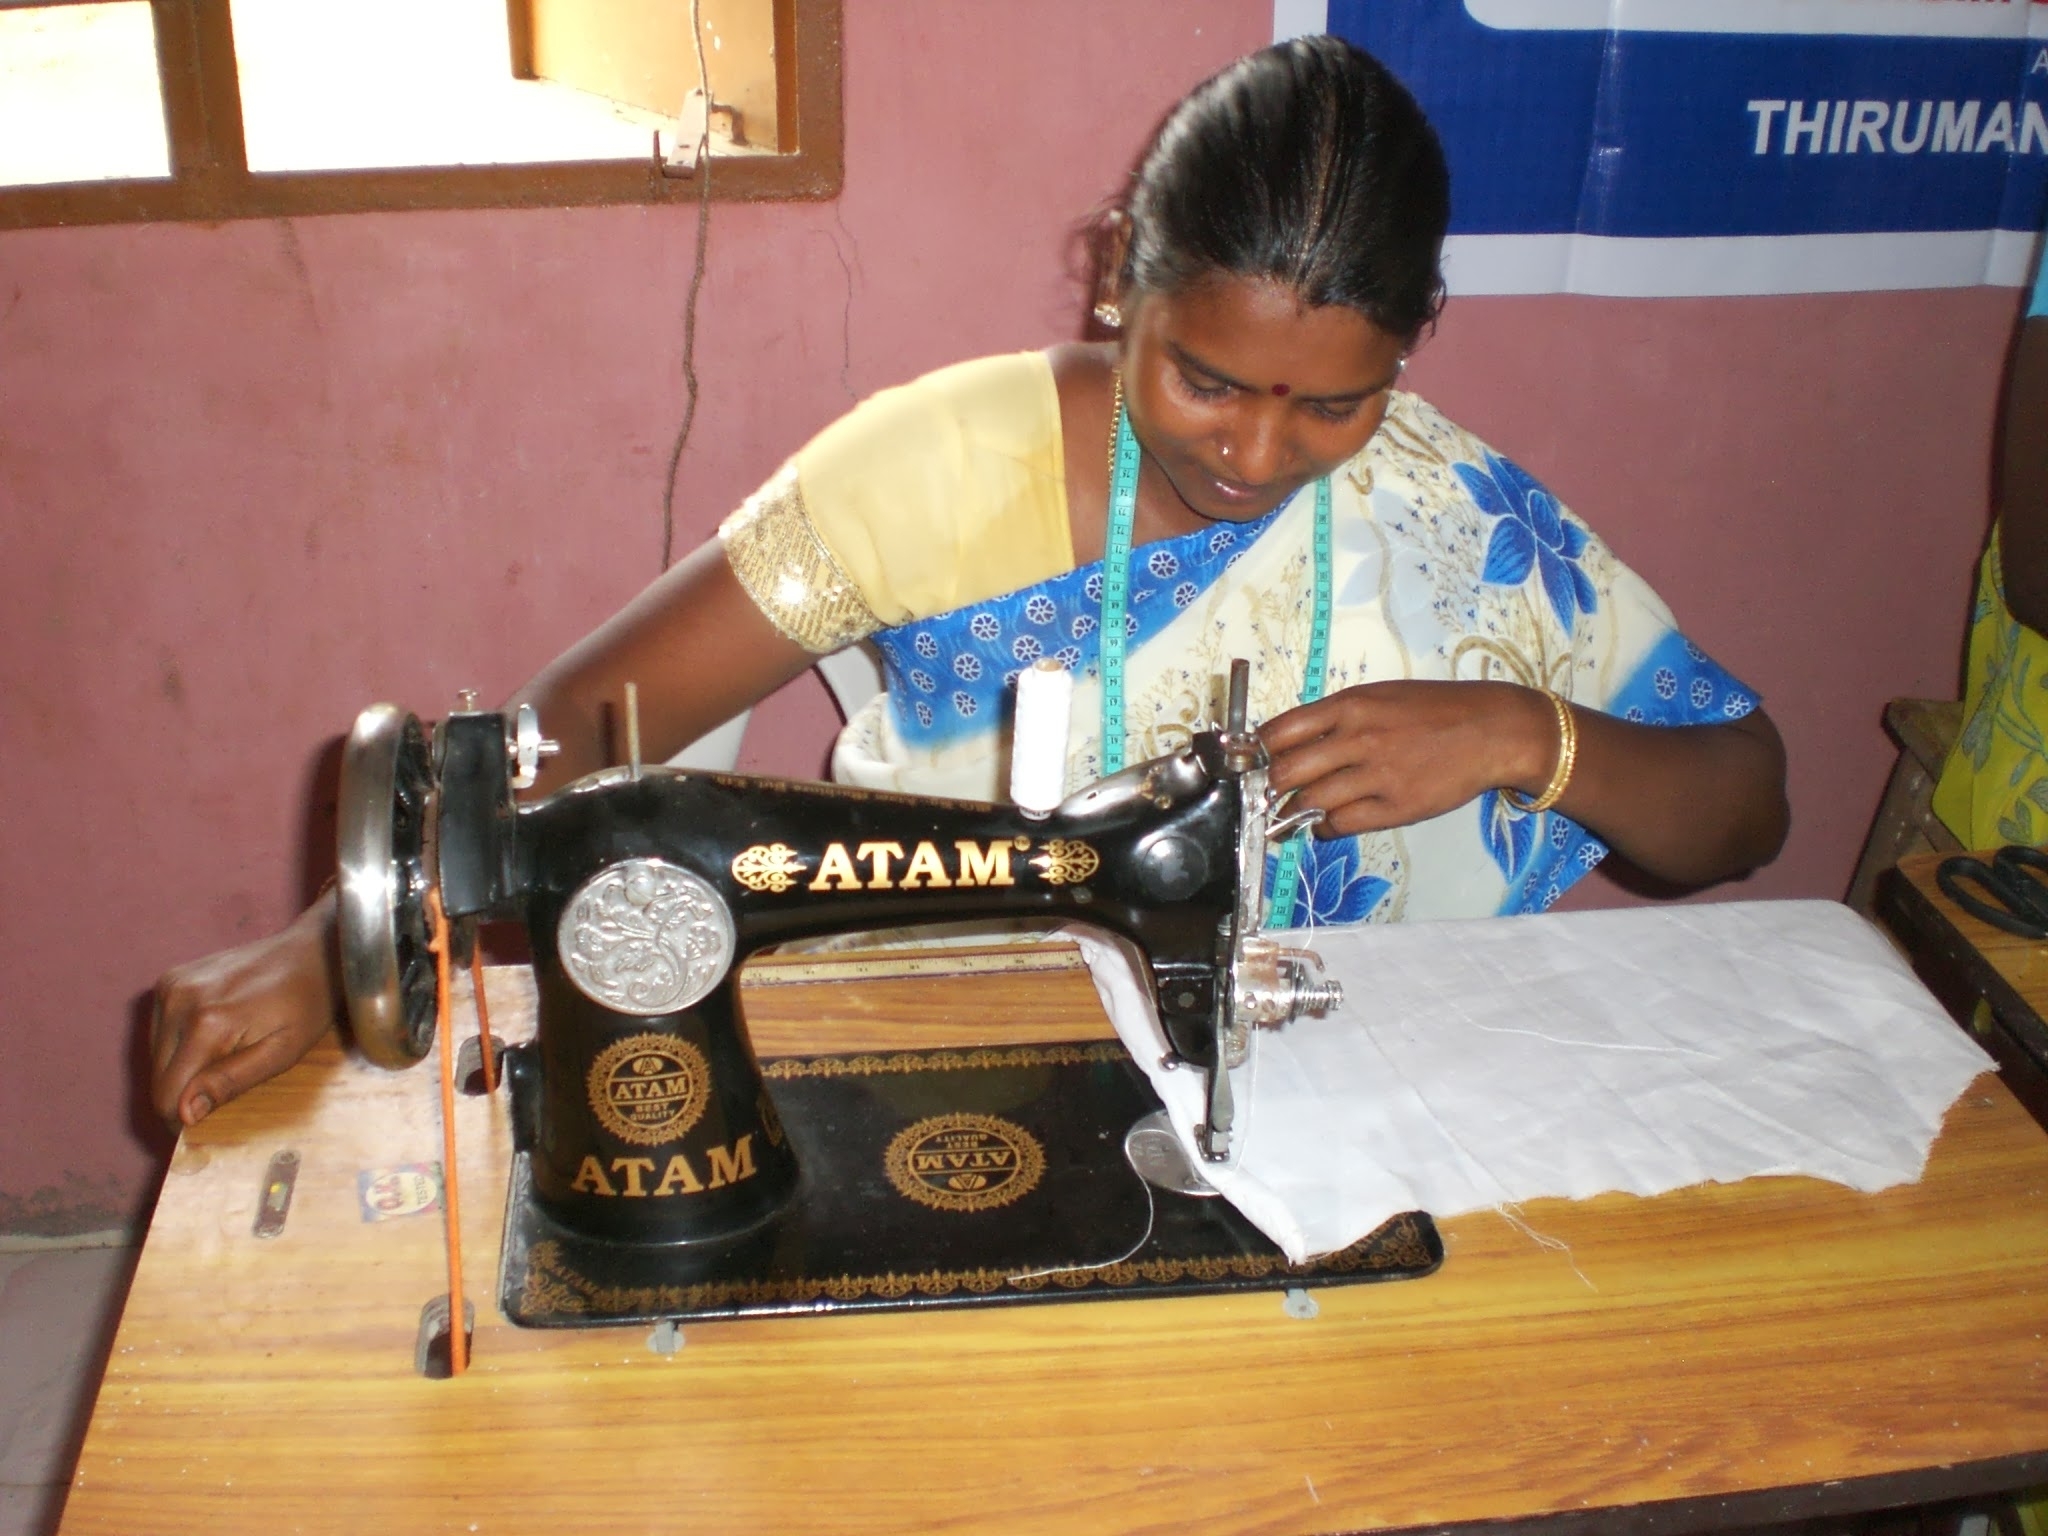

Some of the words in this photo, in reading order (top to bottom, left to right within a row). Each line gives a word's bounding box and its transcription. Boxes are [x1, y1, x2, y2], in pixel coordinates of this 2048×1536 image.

[1747, 100, 2048, 155] THIRUMAN
[808, 840, 1015, 891] ATAM
[614, 1077, 686, 1100] ATAM
[629, 1109, 675, 1121] QUALITY
[571, 1134, 757, 1197] ATAM
[916, 1151, 1011, 1170] ATAM
